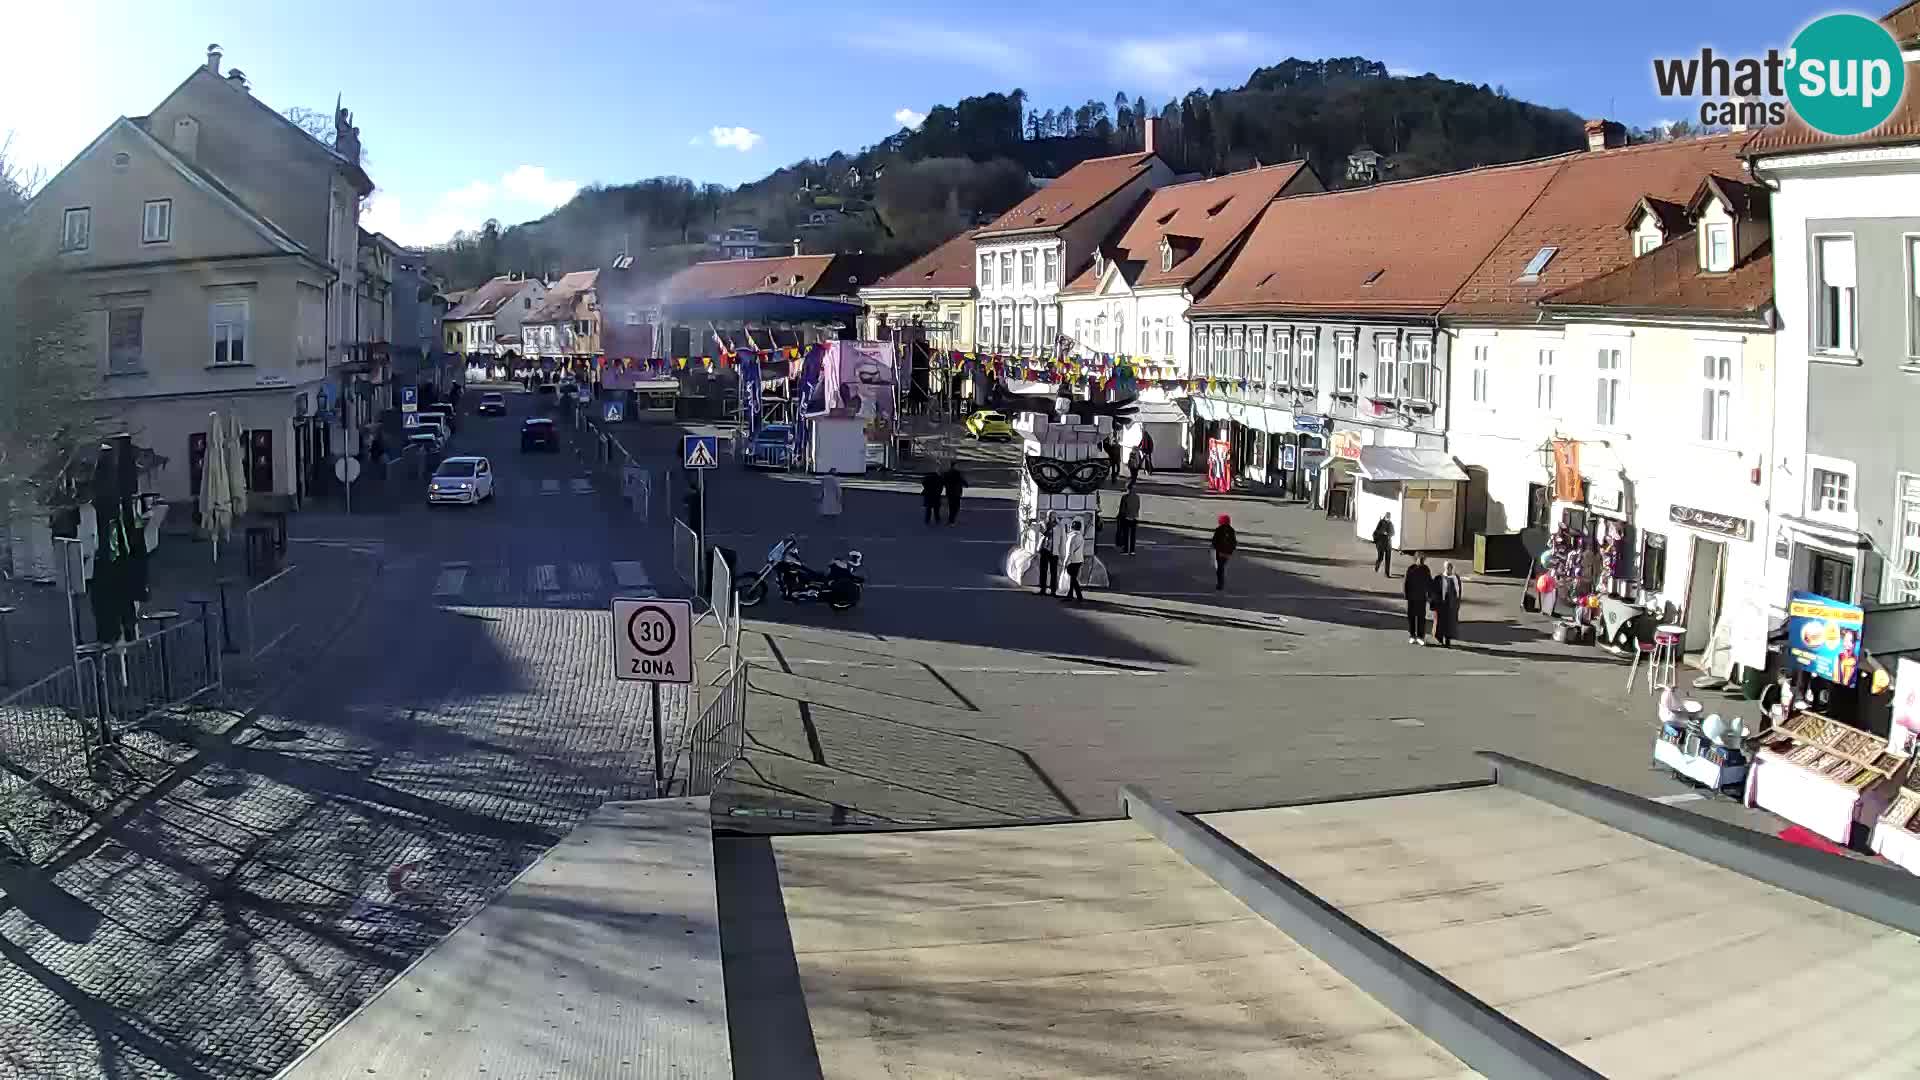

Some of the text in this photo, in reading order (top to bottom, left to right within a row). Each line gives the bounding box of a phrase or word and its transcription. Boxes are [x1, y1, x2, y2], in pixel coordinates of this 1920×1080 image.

[405, 390, 414, 401] P
[640, 621, 665, 642] 30
[631, 658, 675, 676] ZONA
